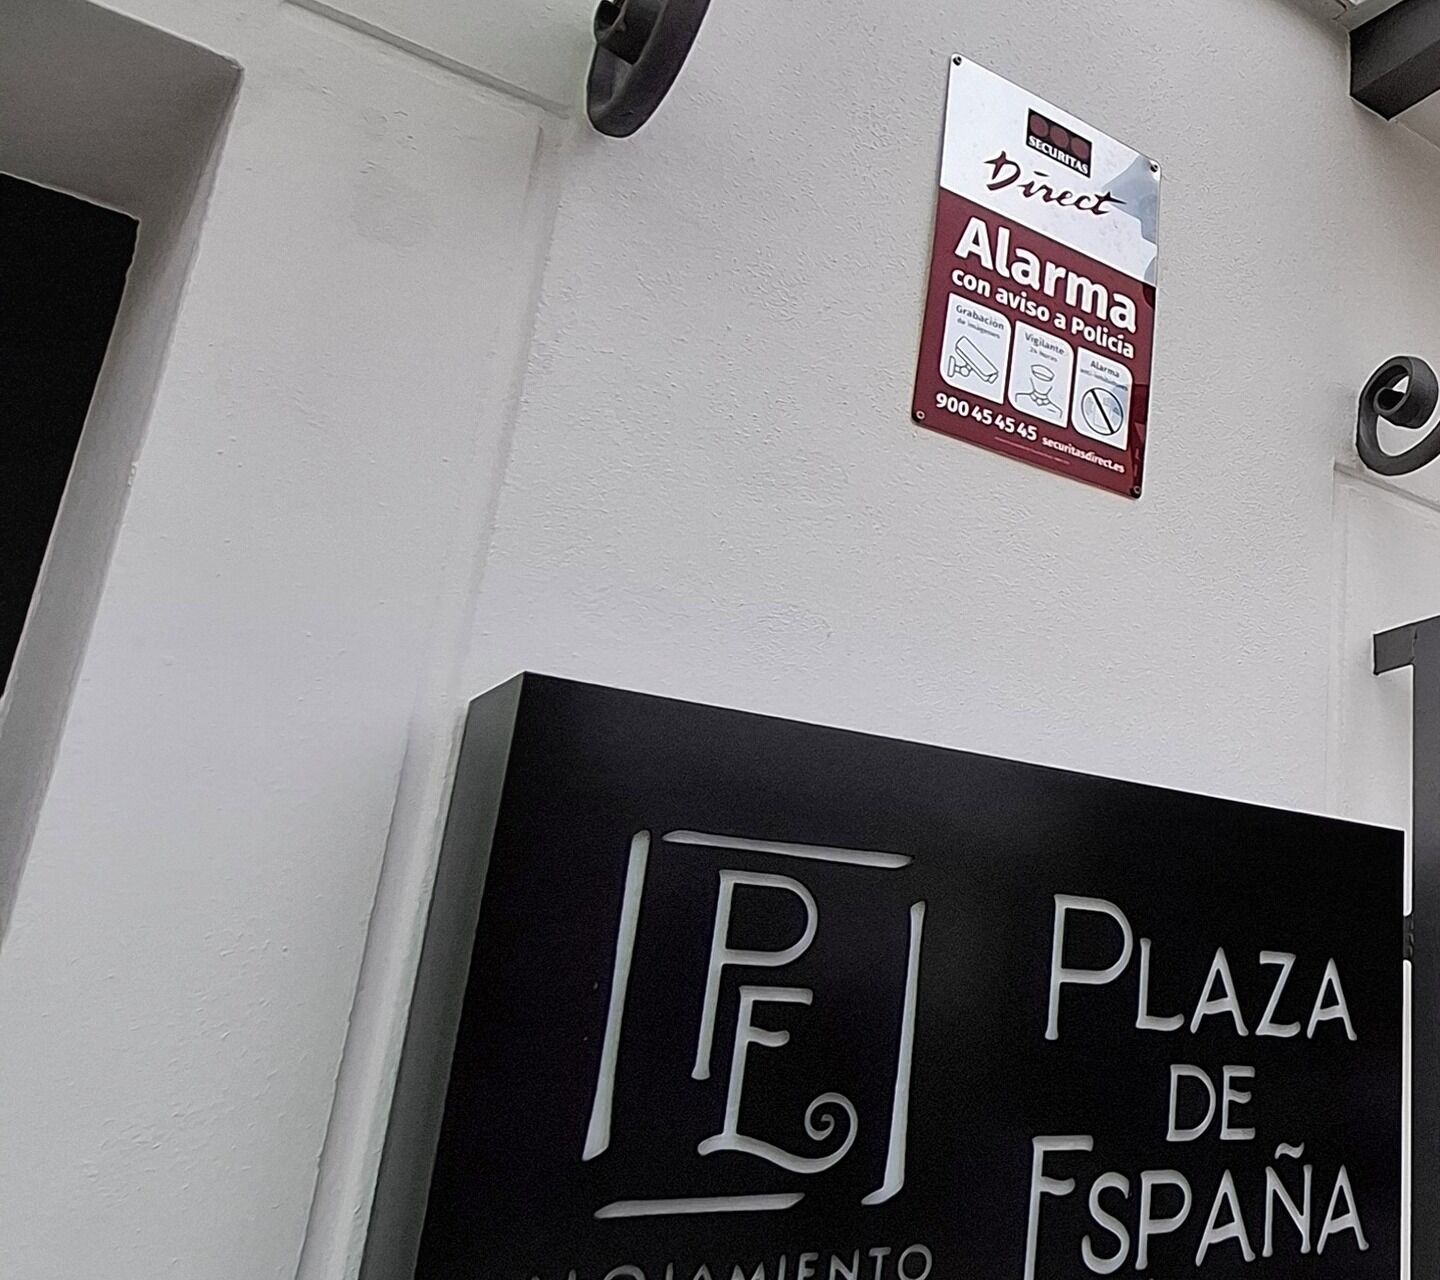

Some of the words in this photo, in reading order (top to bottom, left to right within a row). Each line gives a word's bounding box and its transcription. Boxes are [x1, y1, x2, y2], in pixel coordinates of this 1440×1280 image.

[984, 150, 1127, 215] Direct
[1028, 135, 1089, 175] SECURITAS
[954, 216, 1137, 334] Alarma
[951, 269, 991, 298] con
[996, 287, 1050, 321] aviso
[1053, 312, 1067, 330] a
[1070, 316, 1135, 359] Policía
[1025, 331, 1065, 355] Vigilante
[1091, 360, 1120, 378] Alarma
[936, 392, 969, 417] 900
[971, 405, 993, 425] 45
[994, 414, 1016, 433] 45
[1016, 422, 1038, 441] 45
[1043, 891, 1359, 1041] PLAZA
[1165, 1062, 1257, 1143] DE
